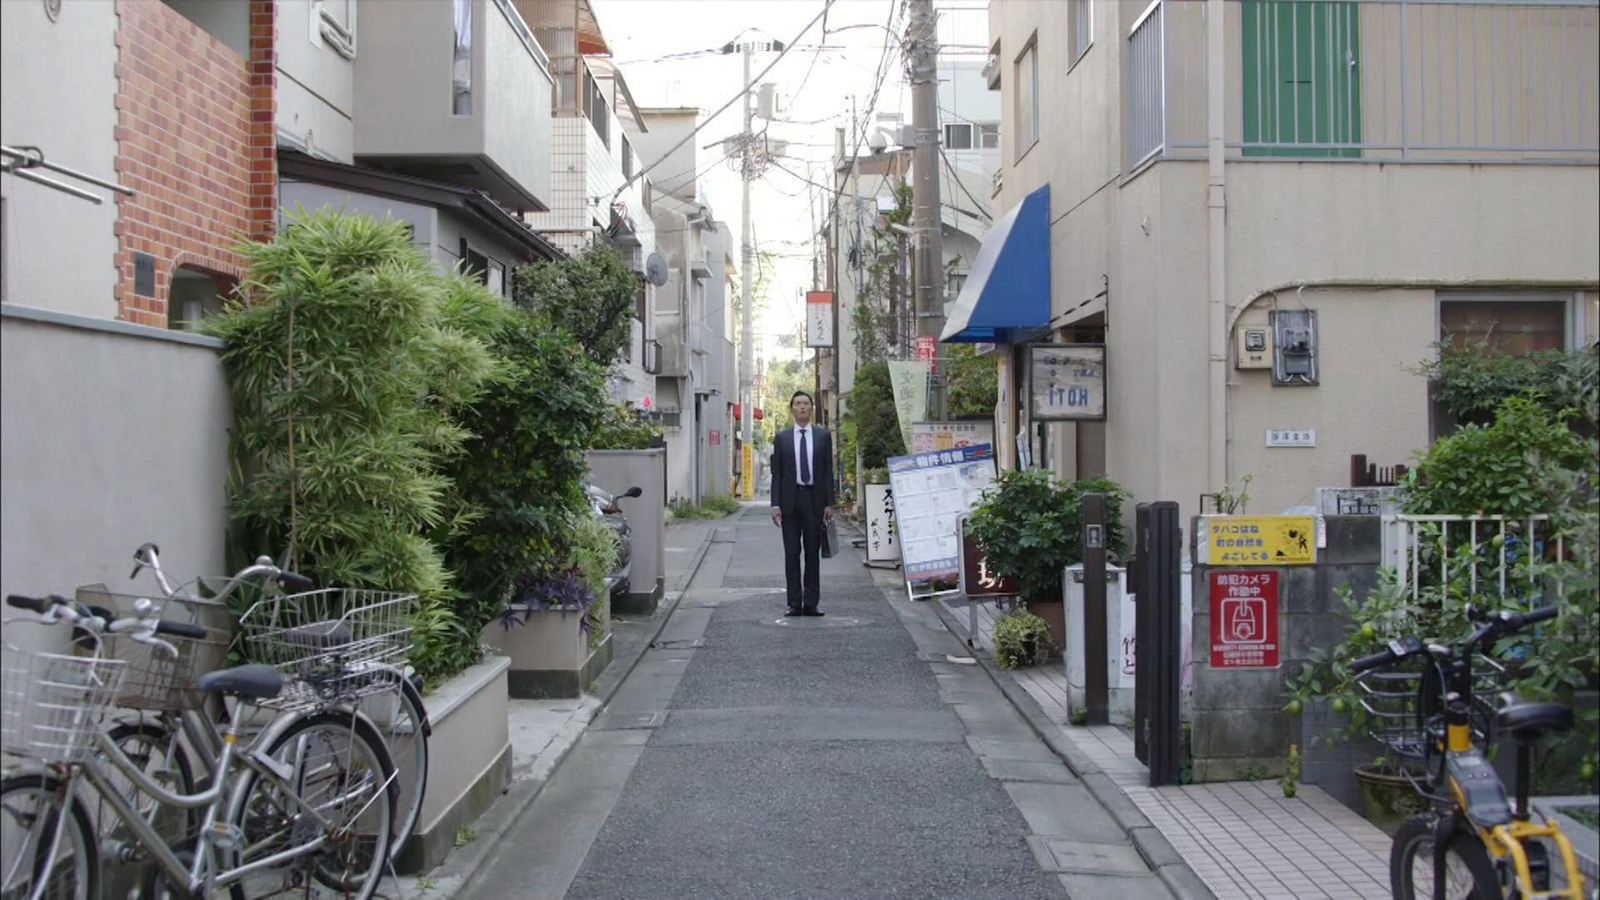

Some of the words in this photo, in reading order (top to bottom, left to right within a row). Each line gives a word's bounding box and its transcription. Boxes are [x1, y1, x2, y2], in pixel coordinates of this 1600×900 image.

[1217, 574, 1271, 586] 防犯カメラ
[1228, 586, 1261, 597] 作動中
